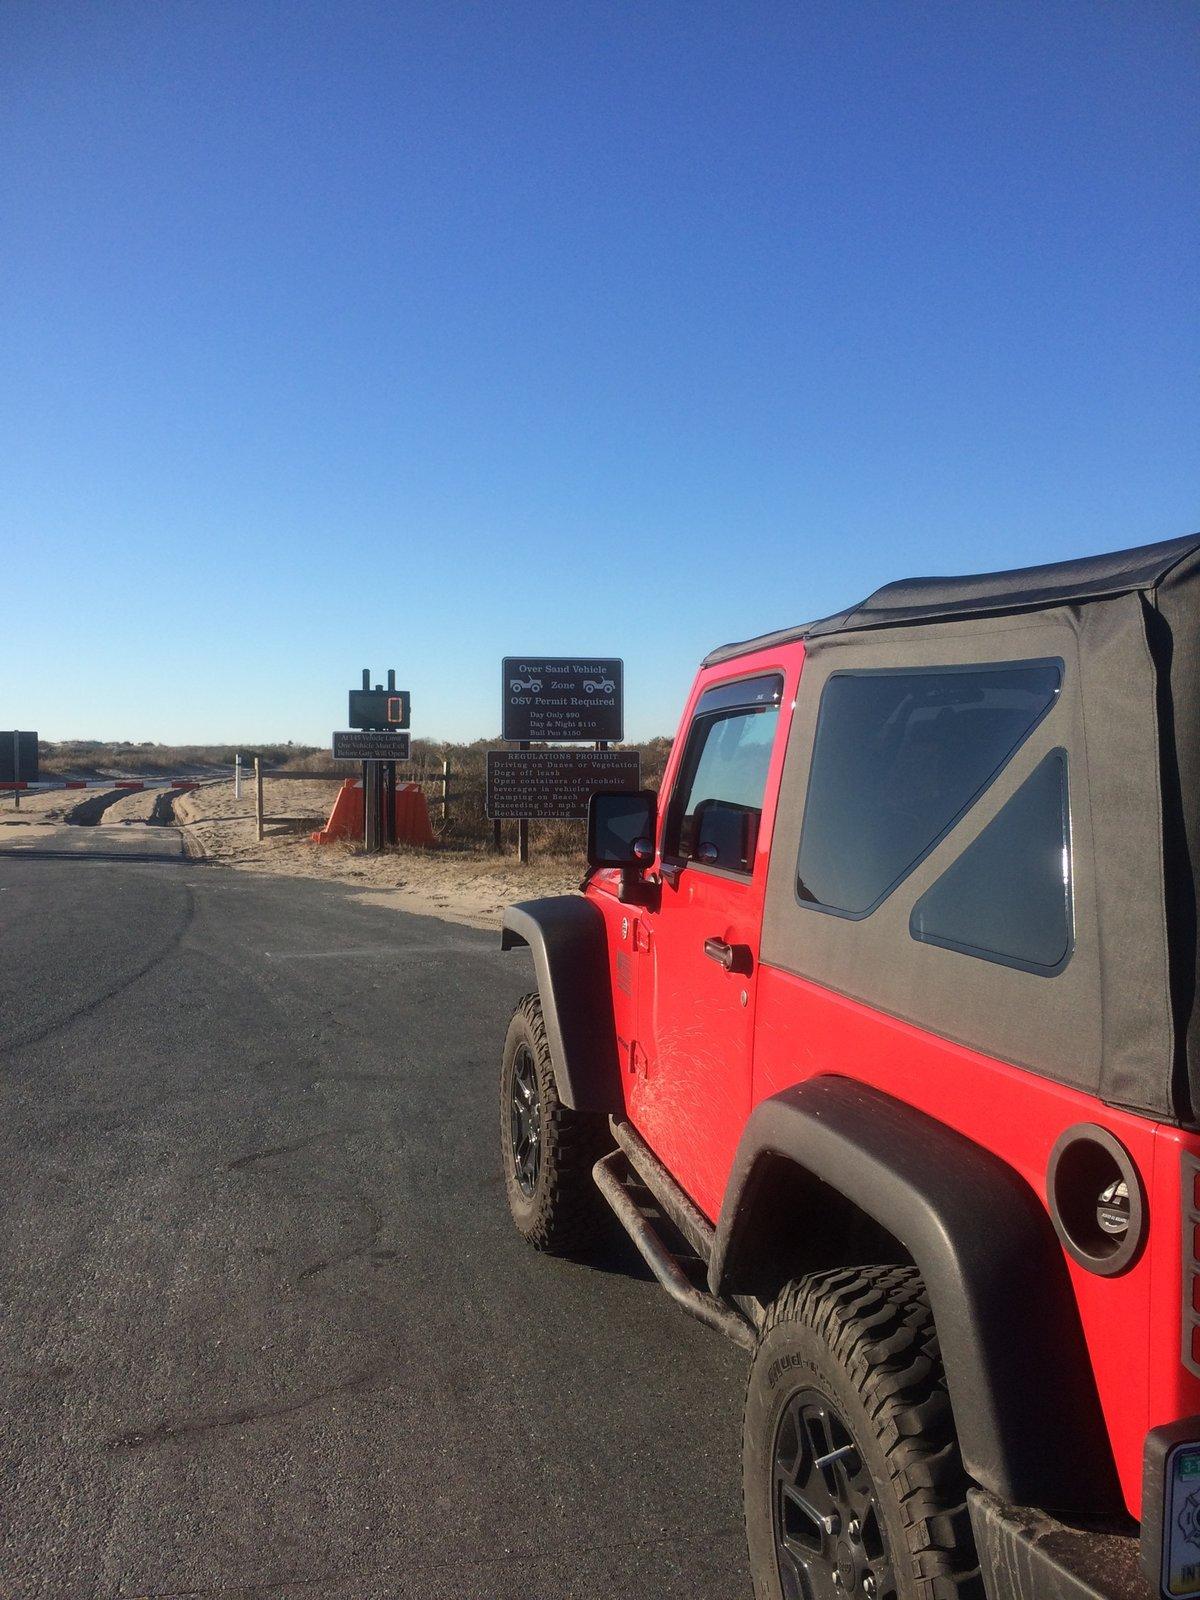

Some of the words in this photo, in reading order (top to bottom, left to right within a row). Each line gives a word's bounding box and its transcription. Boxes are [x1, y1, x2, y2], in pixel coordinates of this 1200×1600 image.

[519, 664, 542, 673] Over
[545, 664, 569, 673] Sand
[573, 665, 607, 674] Vehicle
[551, 681, 575, 690] Zone
[510, 697, 532, 705] OSV
[535, 697, 568, 706] Permit
[571, 697, 615, 708] Required
[388, 697, 402, 723] 0
[529, 711, 545, 719] Day
[546, 711, 564, 719] Only
[566, 711, 580, 719] $90
[529, 720, 545, 728] Day
[555, 720, 576, 729] Night
[529, 729, 545, 737] Bull
[547, 729, 561, 737] Pen
[362, 734, 384, 742] Vehicle
[591, 761, 638, 769] Vegetation
[494, 785, 535, 793] beverages
[558, 801, 577, 809] mph
[537, 809, 571, 817] Driving
